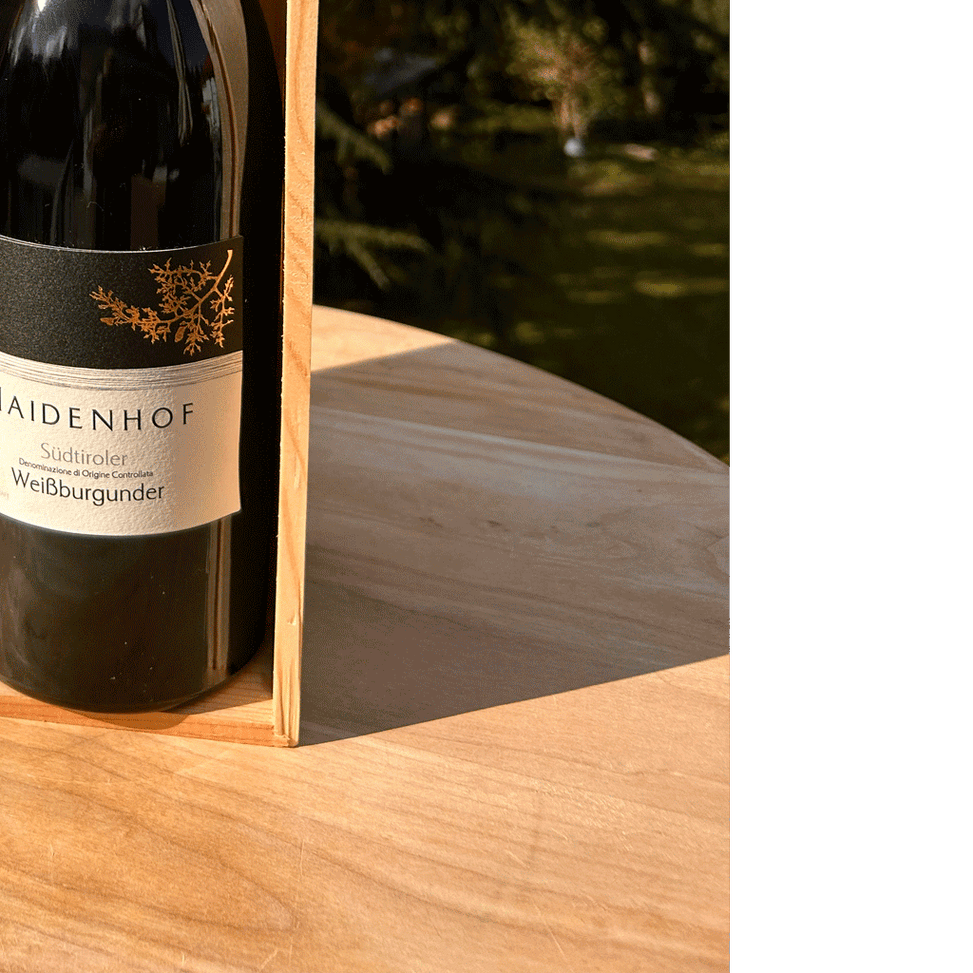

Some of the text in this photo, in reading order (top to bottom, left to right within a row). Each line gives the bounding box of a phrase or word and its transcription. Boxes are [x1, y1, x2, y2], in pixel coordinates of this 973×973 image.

[40, 442, 129, 467] Südtiroler
[18, 457, 154, 480] Denominazione di Origine Controllata
[11, 466, 165, 507] Weißburgunder
